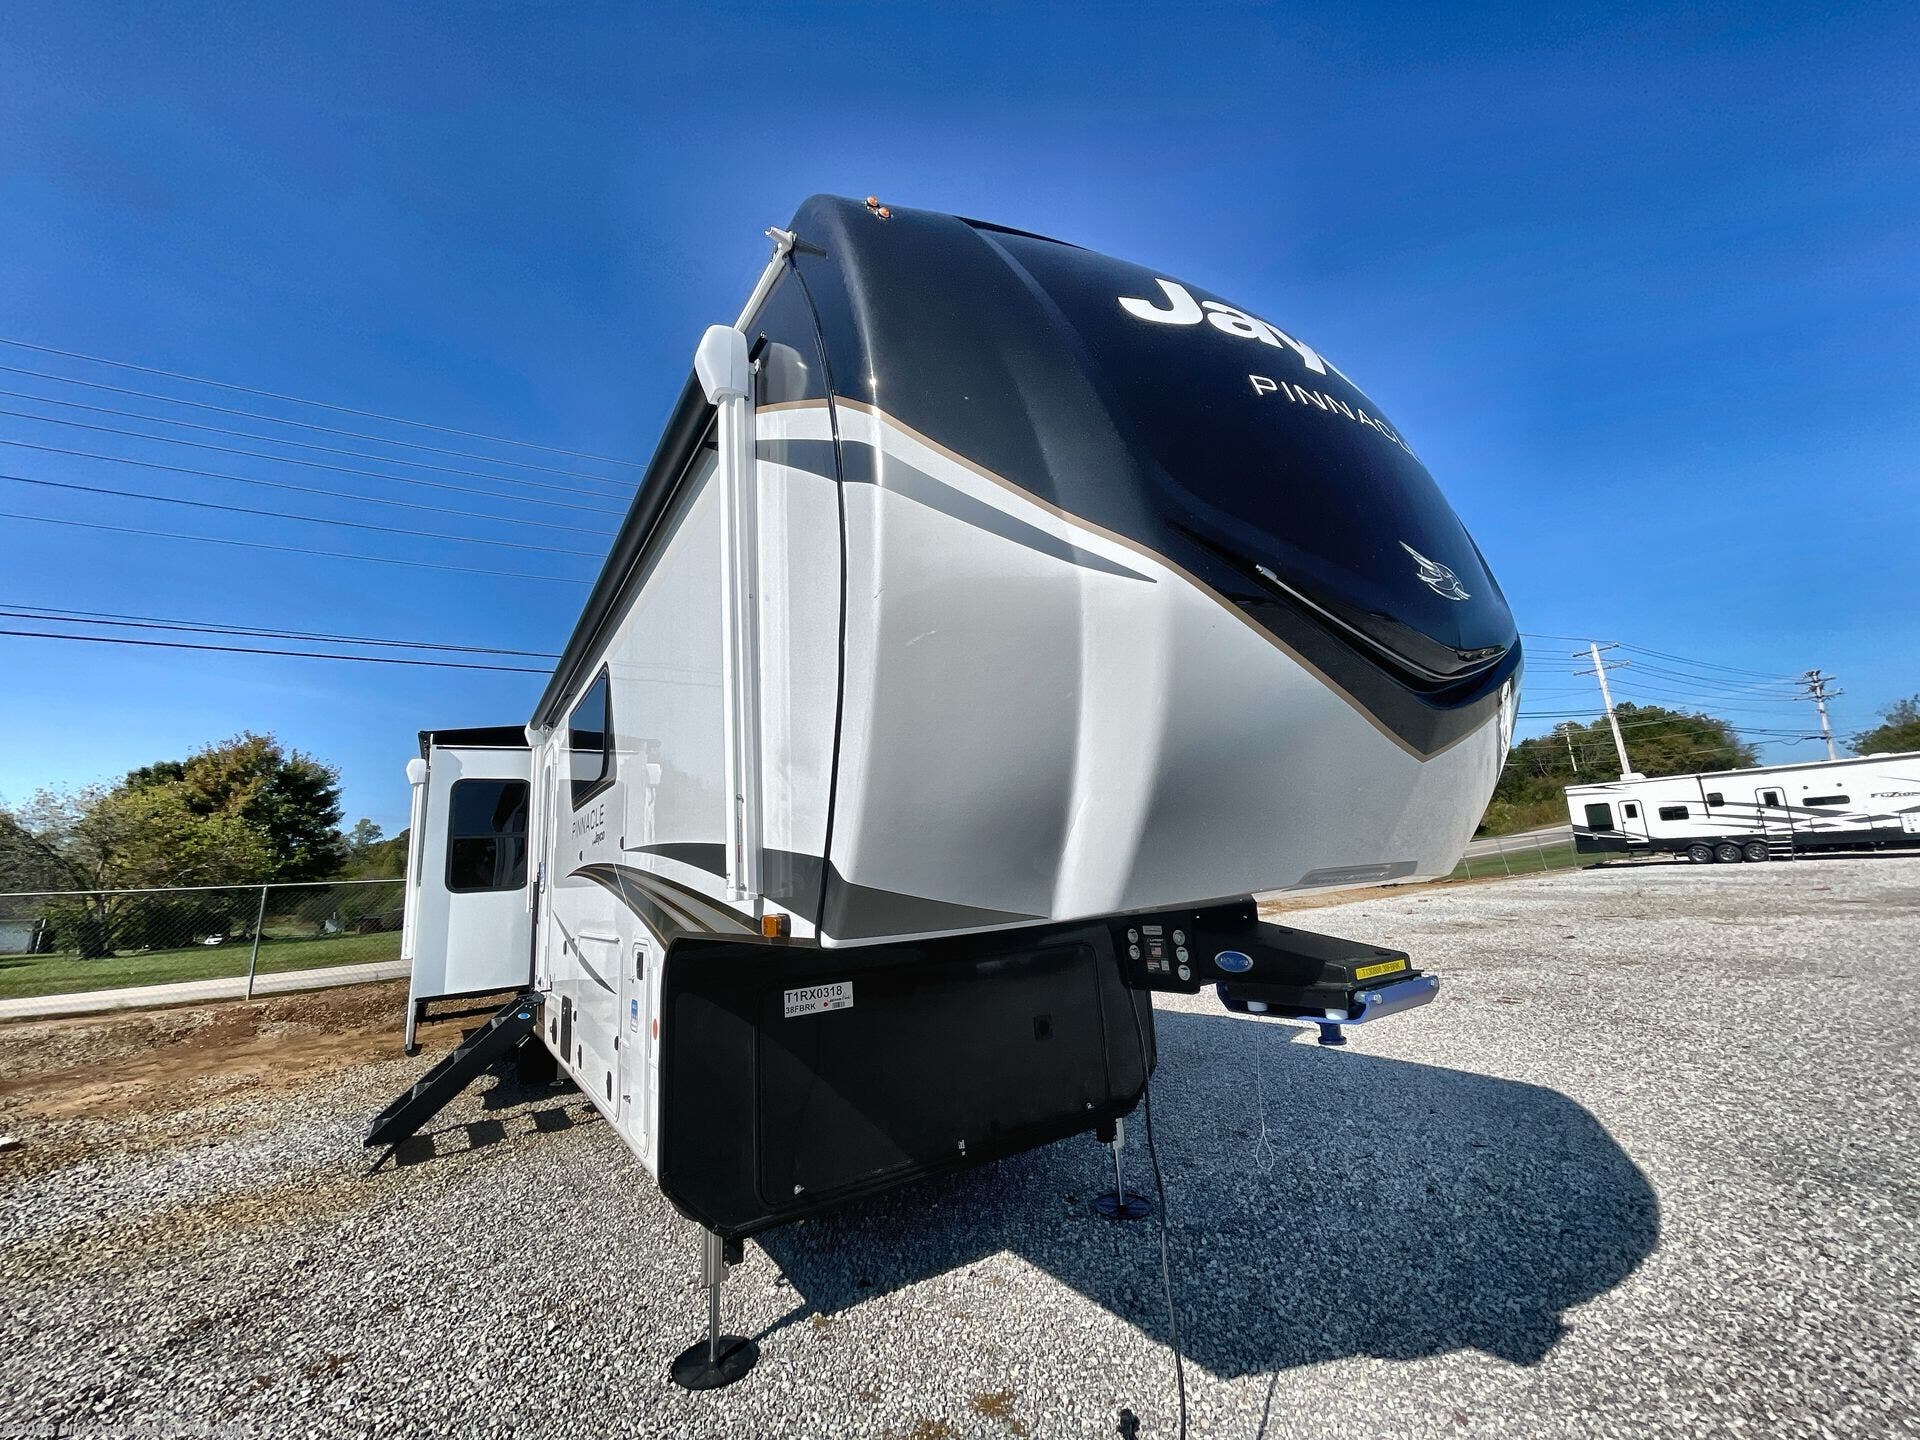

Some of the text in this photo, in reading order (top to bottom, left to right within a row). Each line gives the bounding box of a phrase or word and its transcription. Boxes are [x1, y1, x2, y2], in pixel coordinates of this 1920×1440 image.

[1117, 277, 1350, 386] Jay
[571, 803, 605, 841] PINNACLE
[785, 985, 843, 1004] T1RX0318
[785, 1002, 816, 1015] 38FBRK
